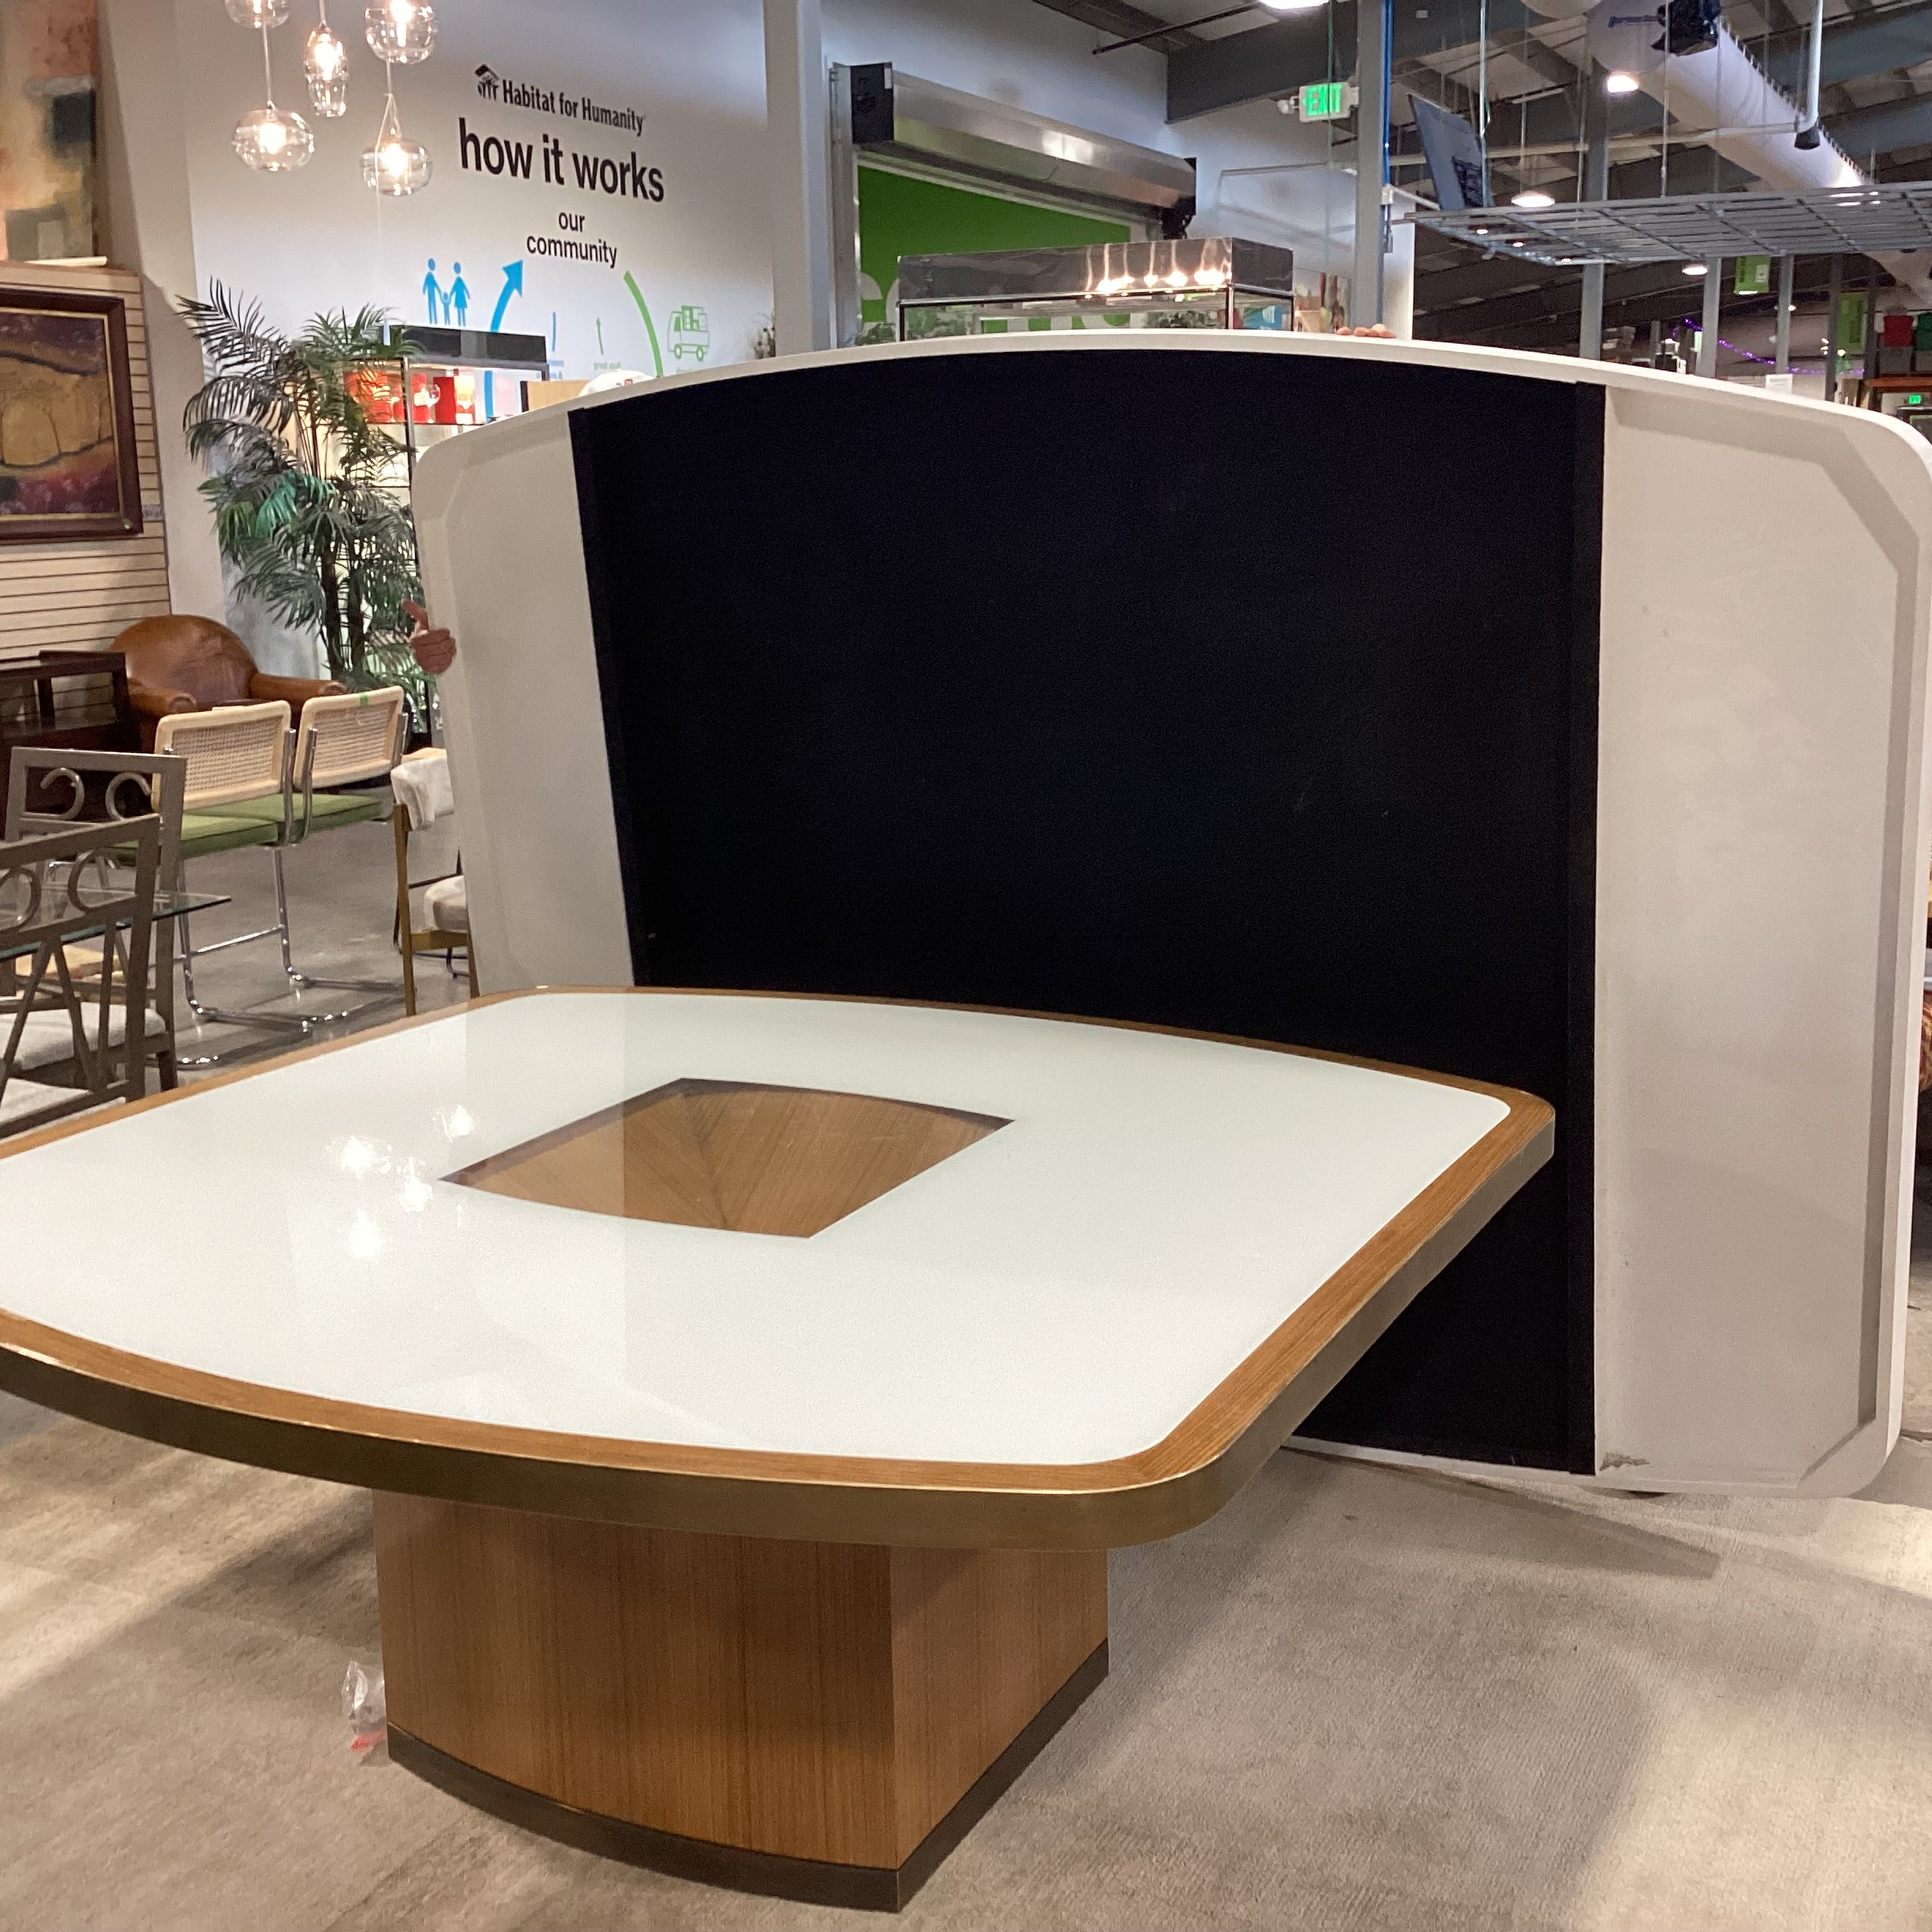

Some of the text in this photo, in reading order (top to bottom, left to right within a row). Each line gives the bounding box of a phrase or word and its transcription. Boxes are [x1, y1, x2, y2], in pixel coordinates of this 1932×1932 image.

[502, 80, 644, 137] Habitat for Humanity
[1307, 84, 1342, 116] EXIT
[459, 117, 665, 203] how it works
[558, 212, 586, 233] our
[526, 235, 618, 269] community
